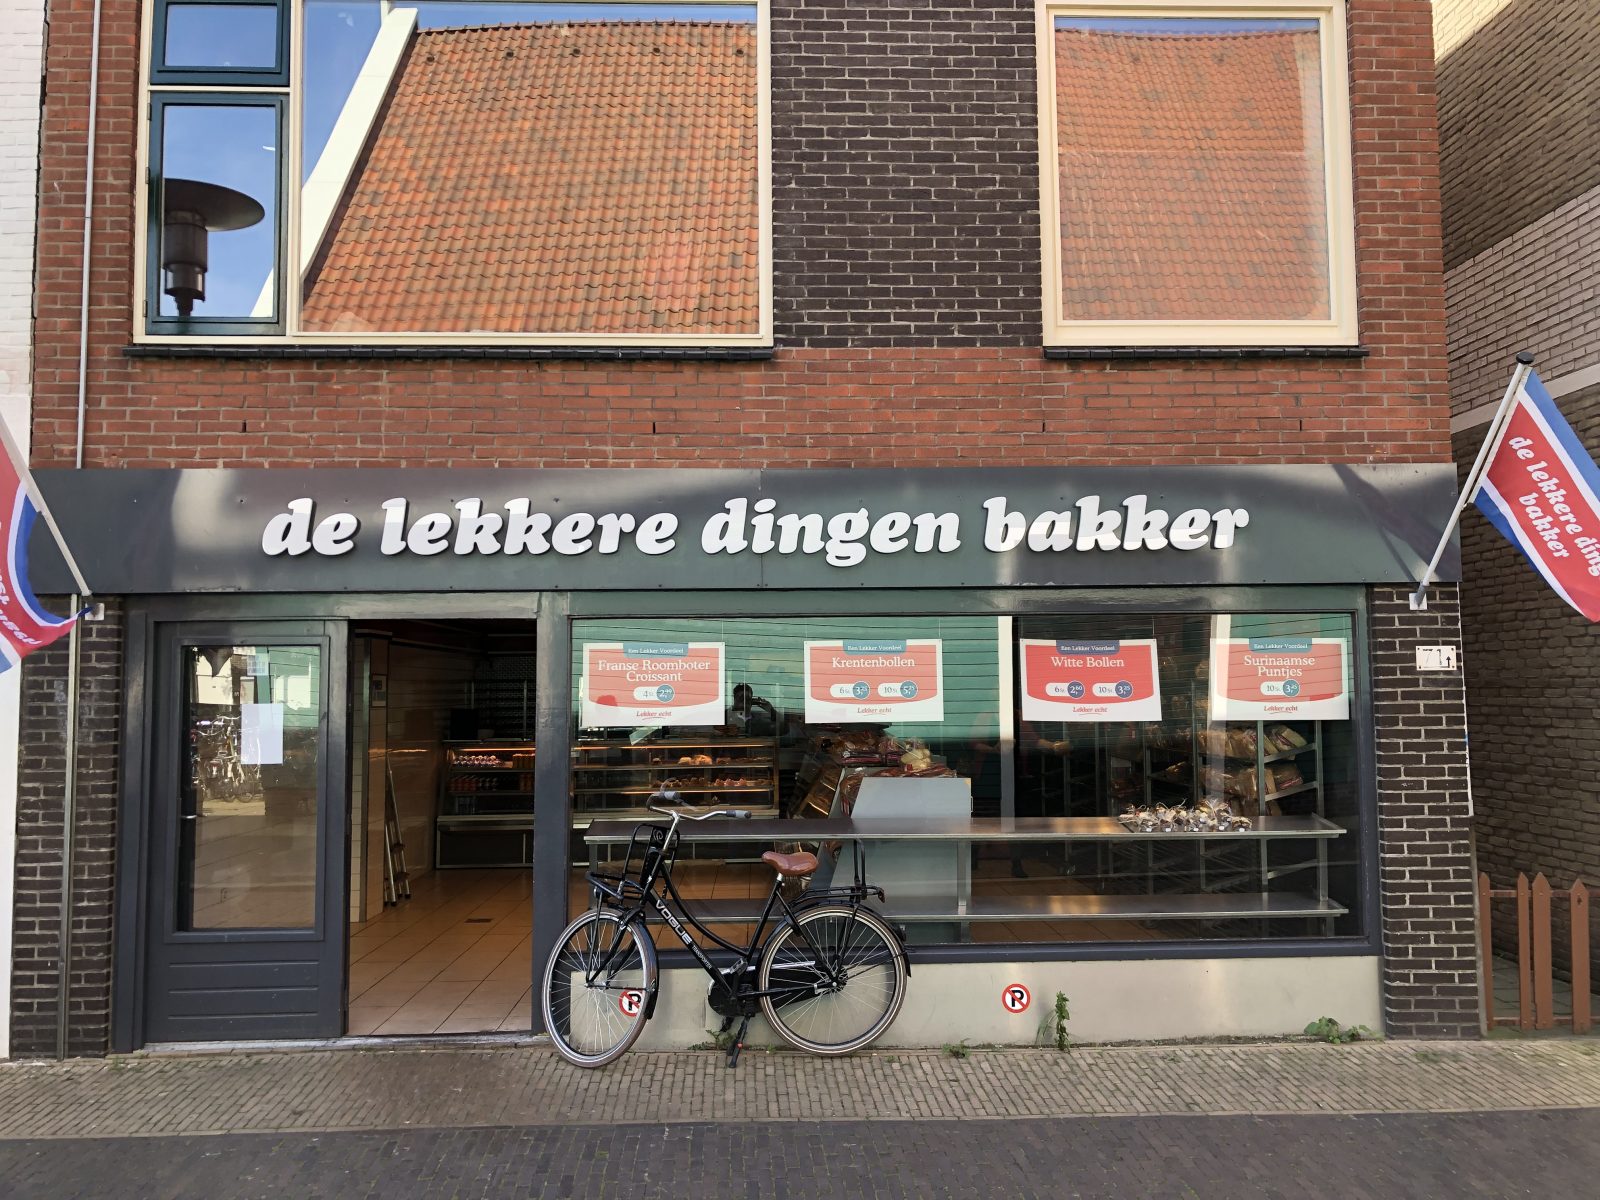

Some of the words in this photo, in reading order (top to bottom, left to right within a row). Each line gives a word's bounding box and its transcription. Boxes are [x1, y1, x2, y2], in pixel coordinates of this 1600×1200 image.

[1509, 436, 1535, 460] de
[1526, 460, 1583, 535] lekkere
[261, 497, 360, 556] de
[380, 497, 679, 556] lekkere
[701, 497, 961, 567] dingen
[982, 494, 1250, 552] bakker
[1519, 492, 1570, 557] bakker
[598, 660, 640, 671] Franse
[642, 659, 711, 671] Roomboter
[832, 656, 916, 668] Krentenbollen
[1050, 656, 1084, 668] Witte
[1086, 656, 1125, 668] Bollen
[1244, 655, 1316, 666] Surinaamse
[626, 670, 683, 682] Croissant
[1258, 666, 1303, 678] Puntjes
[656, 900, 693, 945] VOGUE
